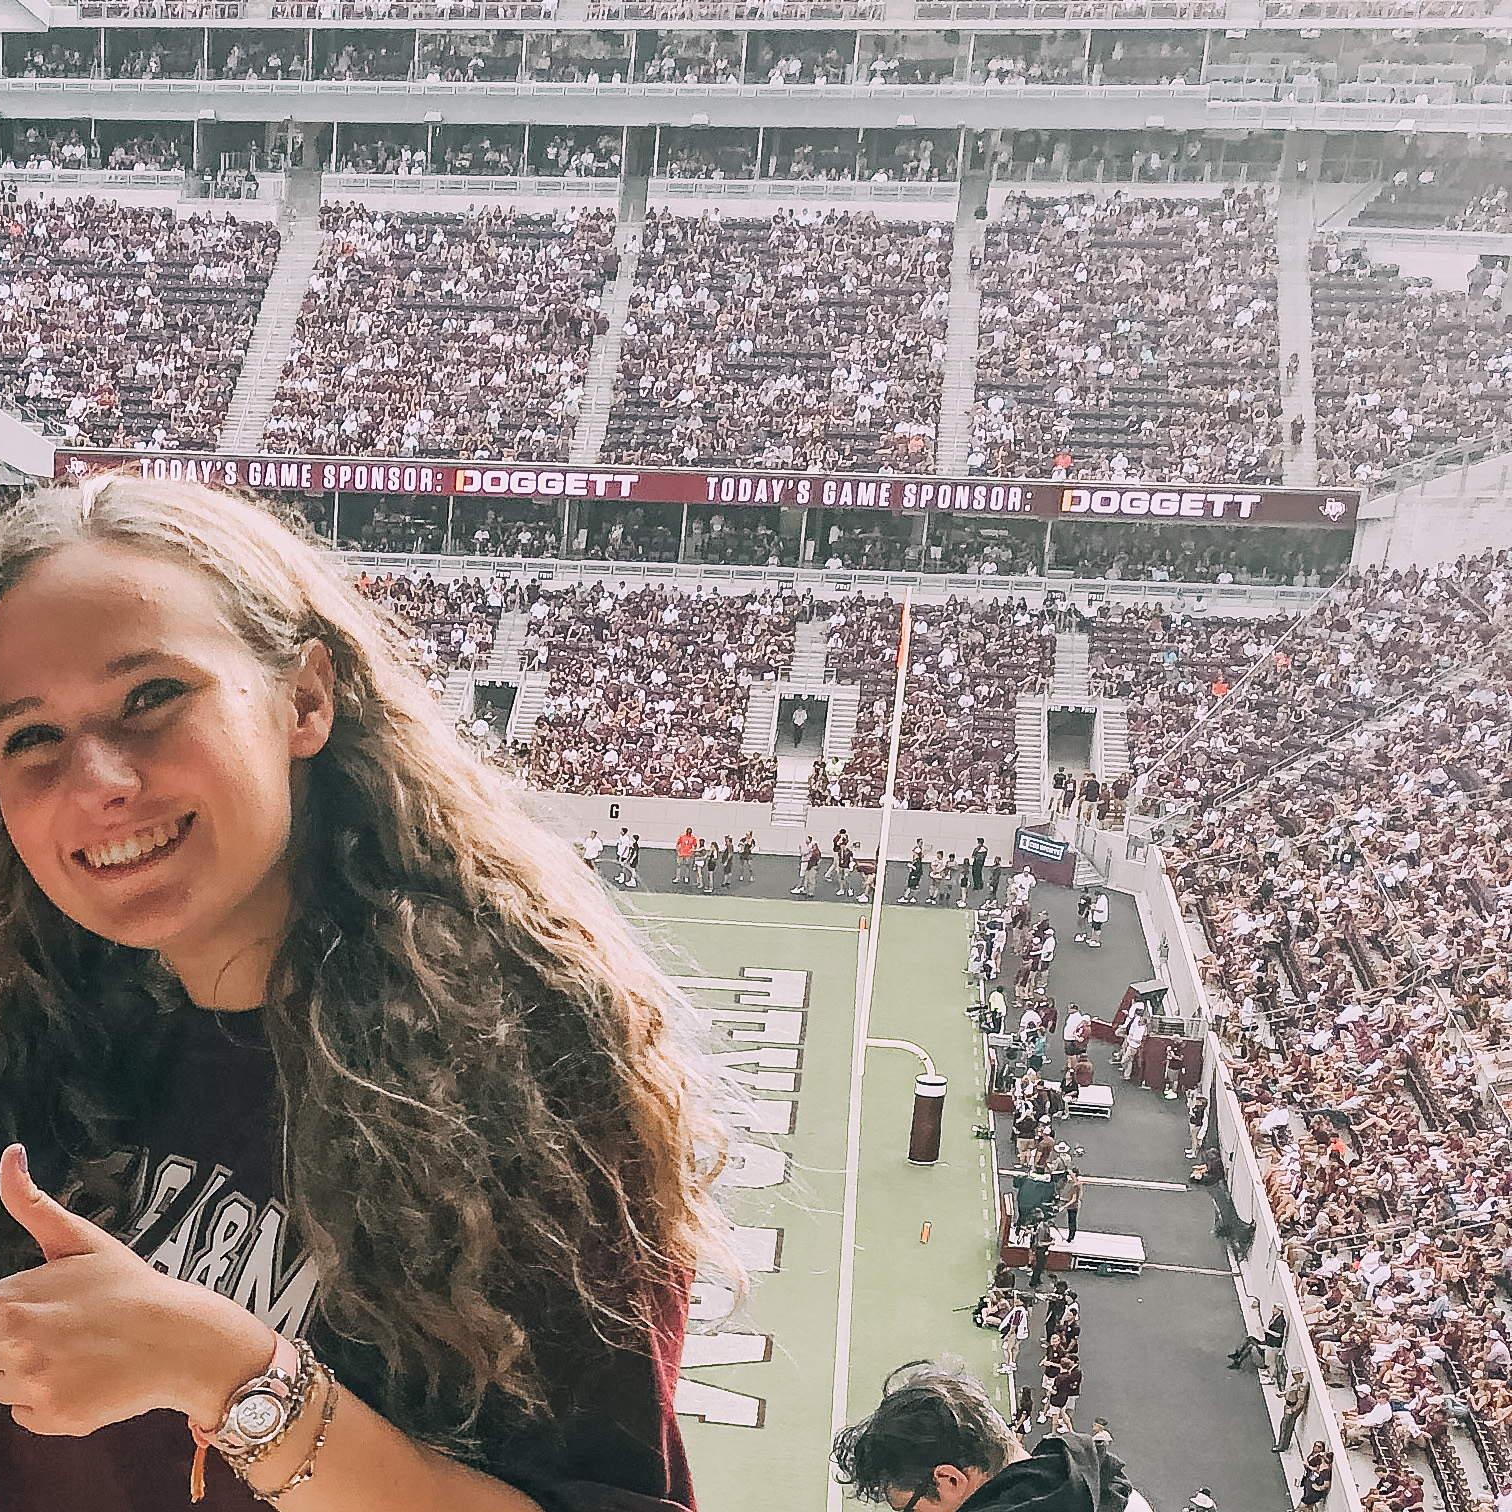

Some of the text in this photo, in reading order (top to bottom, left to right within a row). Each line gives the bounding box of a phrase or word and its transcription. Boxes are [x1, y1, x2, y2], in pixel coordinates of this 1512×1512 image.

[139, 458, 443, 493] TODAY'S GAME SPONSOR:
[455, 470, 639, 498] DOGGETT
[705, 476, 1033, 513] TODAY'S GAME SPONSOR:
[1061, 489, 1262, 519] DOGGETT
[609, 803, 620, 819] G
